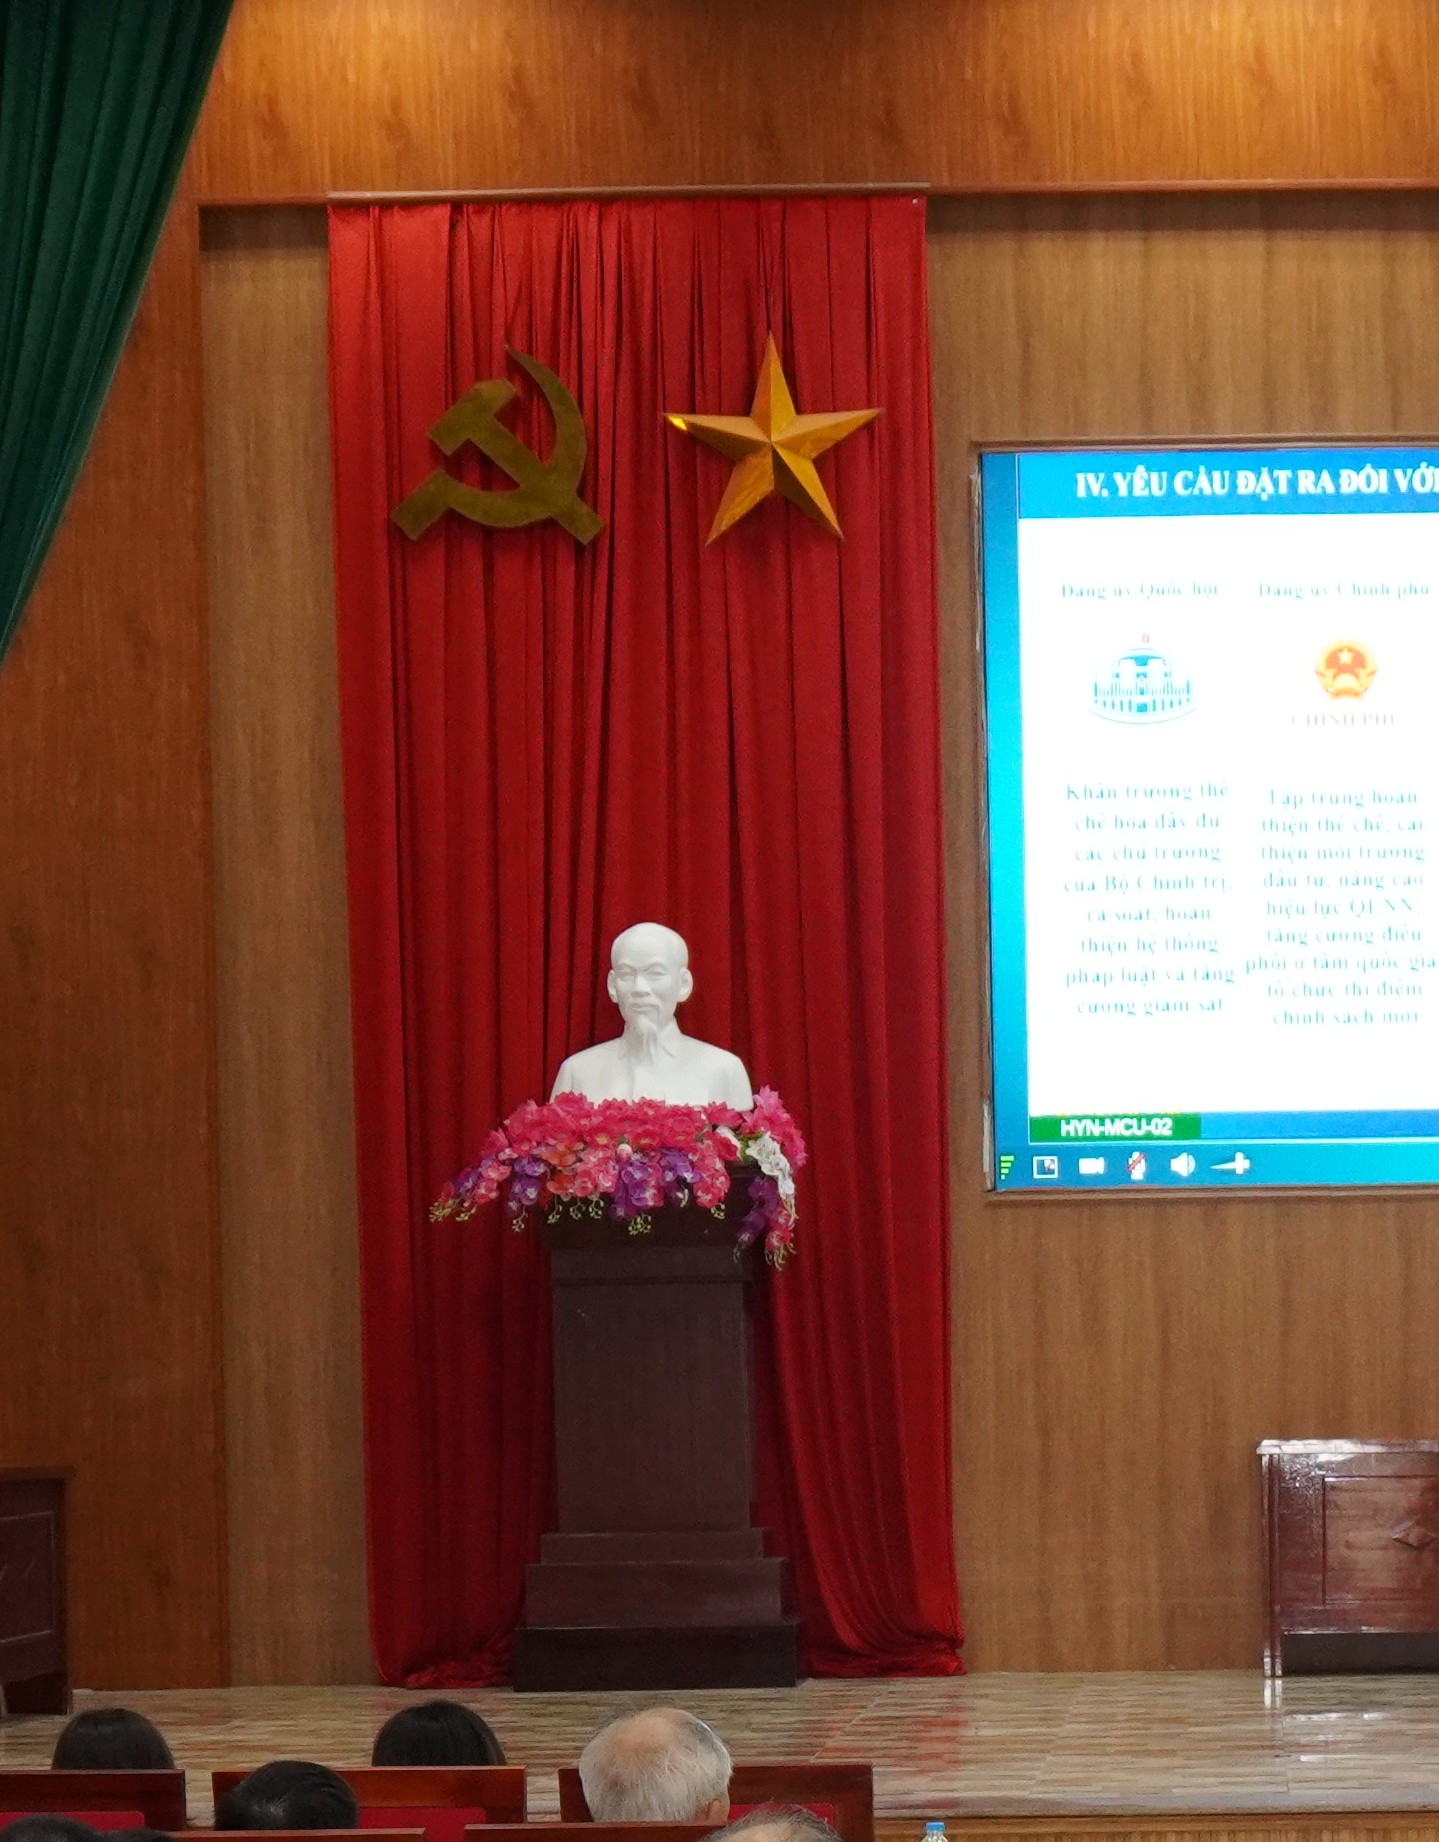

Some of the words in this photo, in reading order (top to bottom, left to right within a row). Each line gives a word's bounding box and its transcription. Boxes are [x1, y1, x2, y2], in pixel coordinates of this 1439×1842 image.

[1076, 471, 1108, 498] IV.
[1113, 464, 1167, 497] YÊU
[1236, 465, 1292, 501] ĐẶT
[1297, 468, 1338, 494] RA
[1060, 1117, 1172, 1137] HYN-MCU-02
